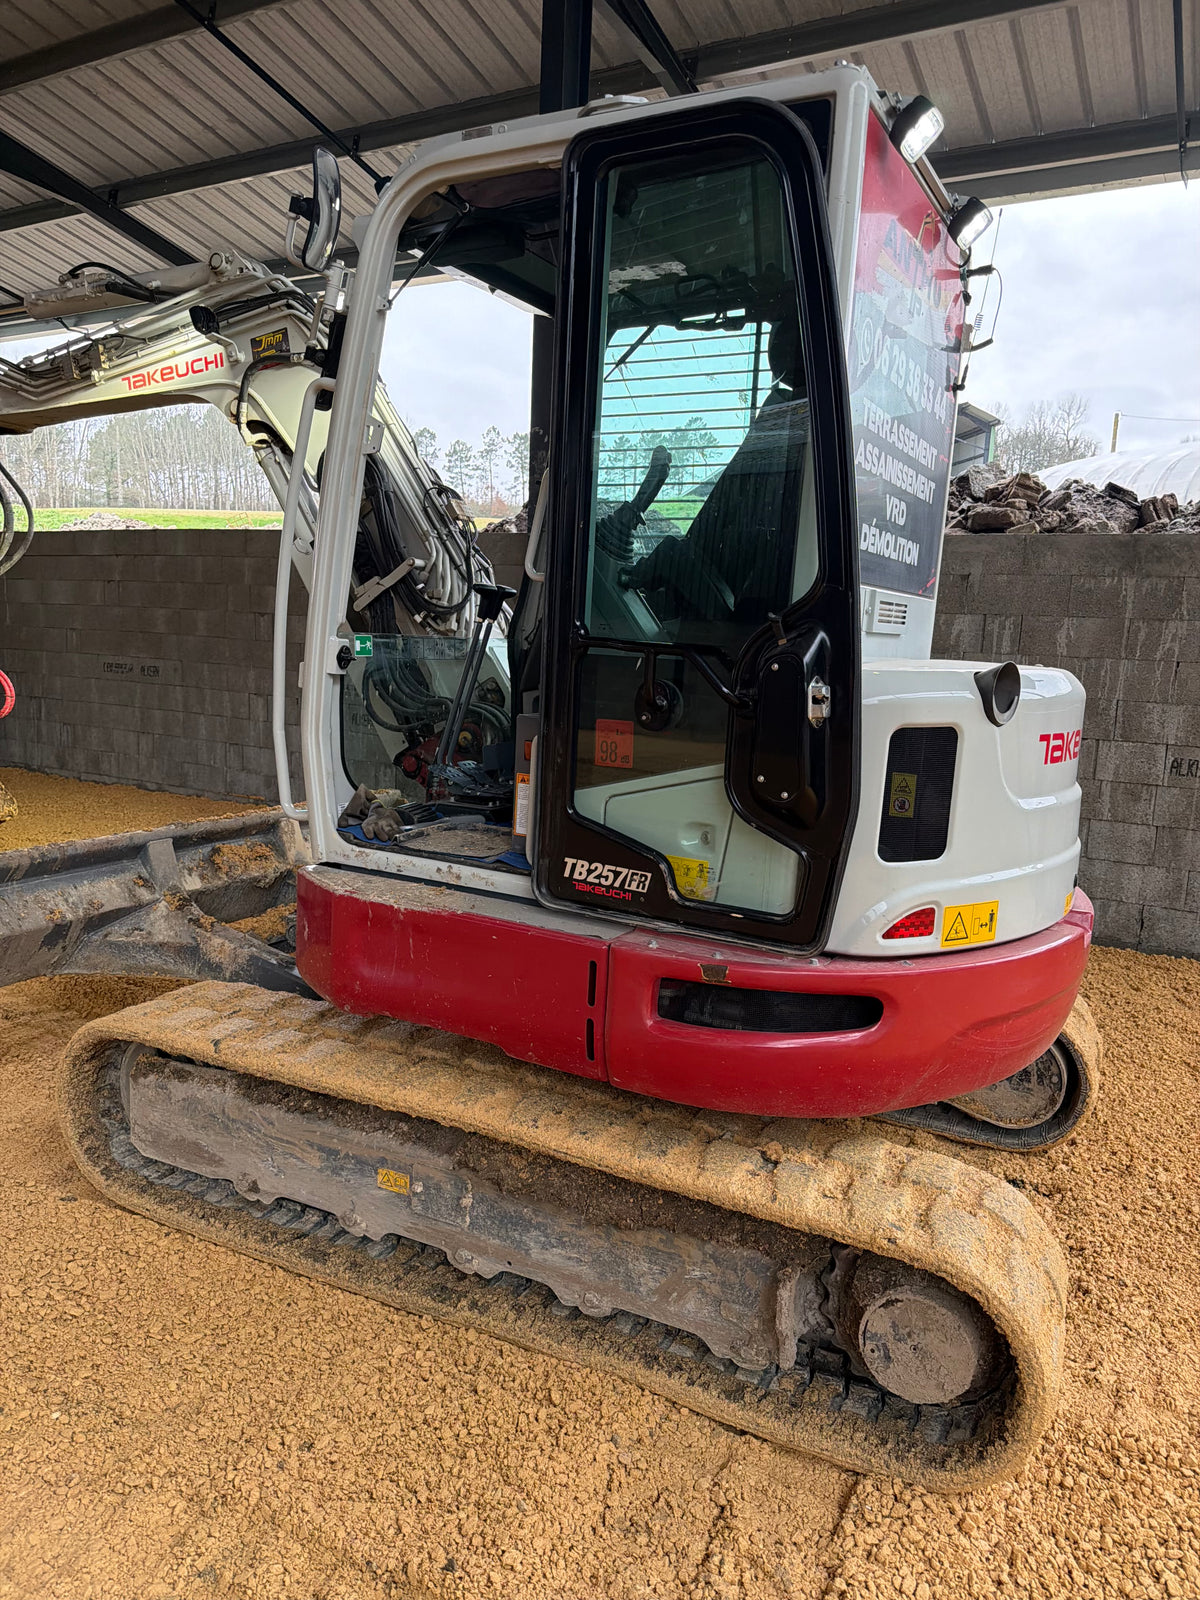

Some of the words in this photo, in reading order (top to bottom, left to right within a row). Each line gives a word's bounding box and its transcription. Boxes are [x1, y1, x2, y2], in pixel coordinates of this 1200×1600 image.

[873, 327, 890, 376] 06
[890, 344, 906, 389] 29
[921, 371, 935, 413] 33
[934, 386, 946, 425] 44
[863, 397, 938, 471] TERRASSEMENT
[855, 437, 936, 505] ASSAINISSEMENT
[886, 493, 907, 527] VRD
[860, 518, 920, 567] DÉMOLITION
[600, 740, 618, 763] 98
